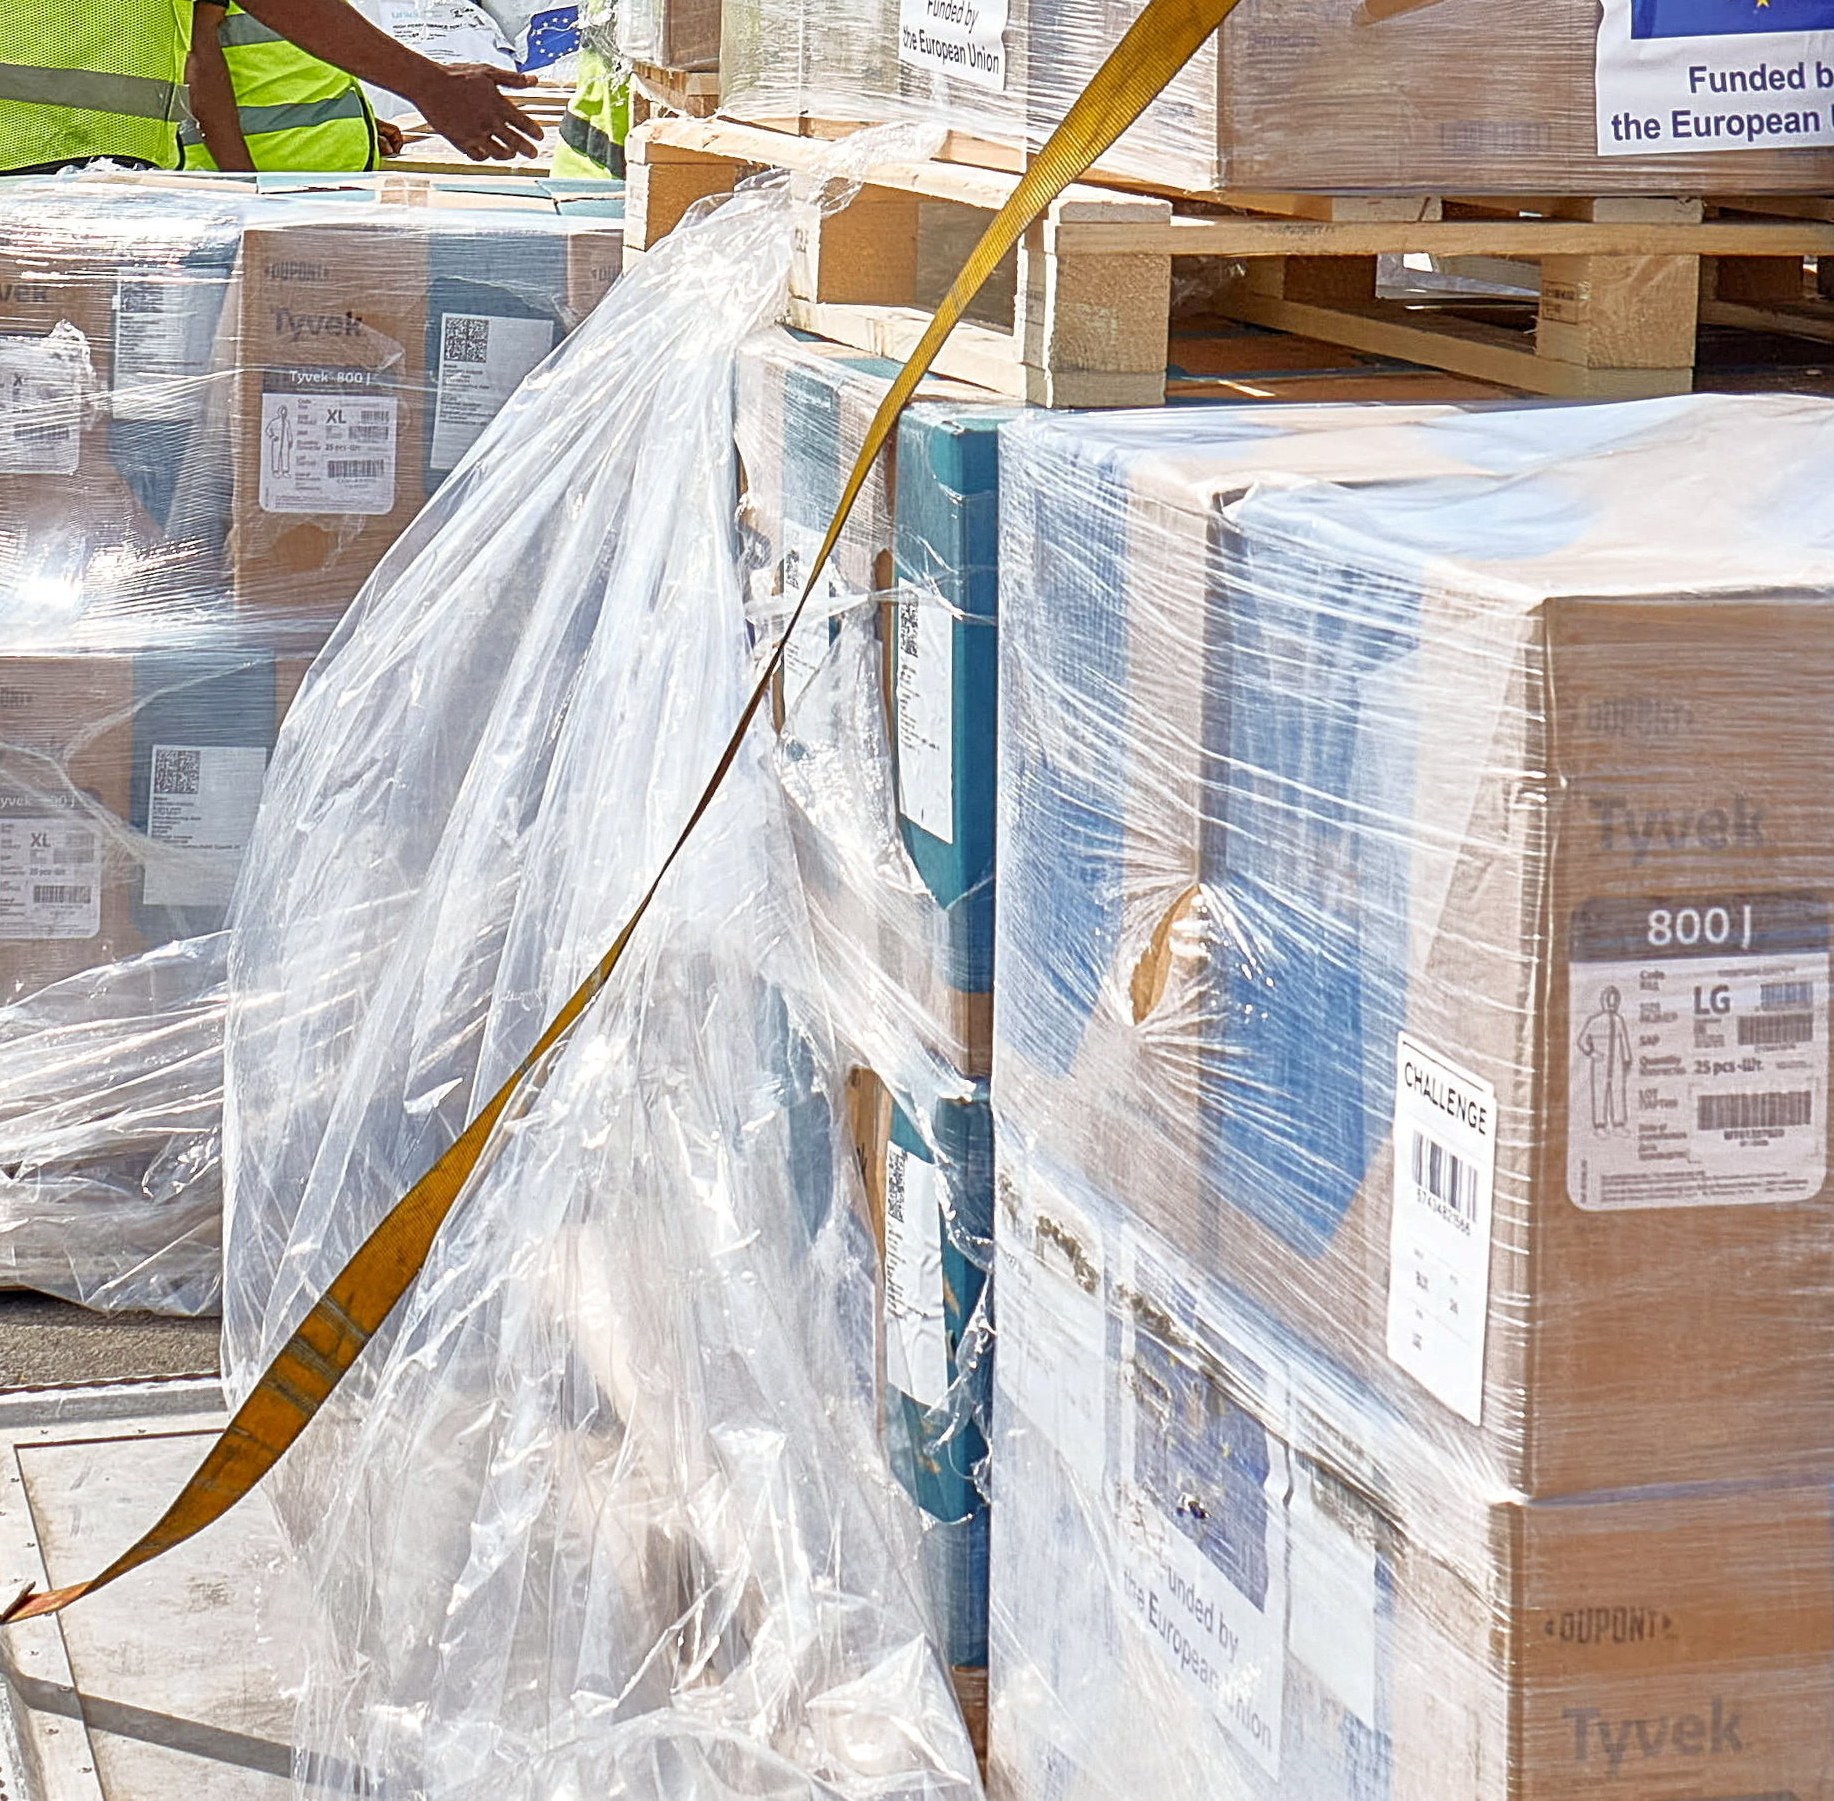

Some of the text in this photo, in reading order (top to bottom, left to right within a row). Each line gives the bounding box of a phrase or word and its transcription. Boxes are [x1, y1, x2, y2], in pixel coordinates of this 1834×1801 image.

[964, 2, 979, 34] by
[903, 25, 999, 75] the European Union
[1688, 63, 1805, 94] Funded
[1611, 112, 1661, 141] the
[1672, 108, 1819, 142] European
[337, 372, 363, 383] 800
[326, 409, 346, 424] XL
[31, 833, 50, 847] XL
[1591, 796, 1769, 868] Tyvek
[1648, 905, 1751, 949] 800 J
[1694, 985, 1731, 1015] LG
[1694, 1060, 1737, 1078] 25 pcs
[1404, 1061, 1487, 1135] CHALLENGE
[1166, 1566, 1238, 1663] unded by
[1560, 1607, 1657, 1644] DUPONT
[1562, 1697, 1744, 1776] Tyvek
